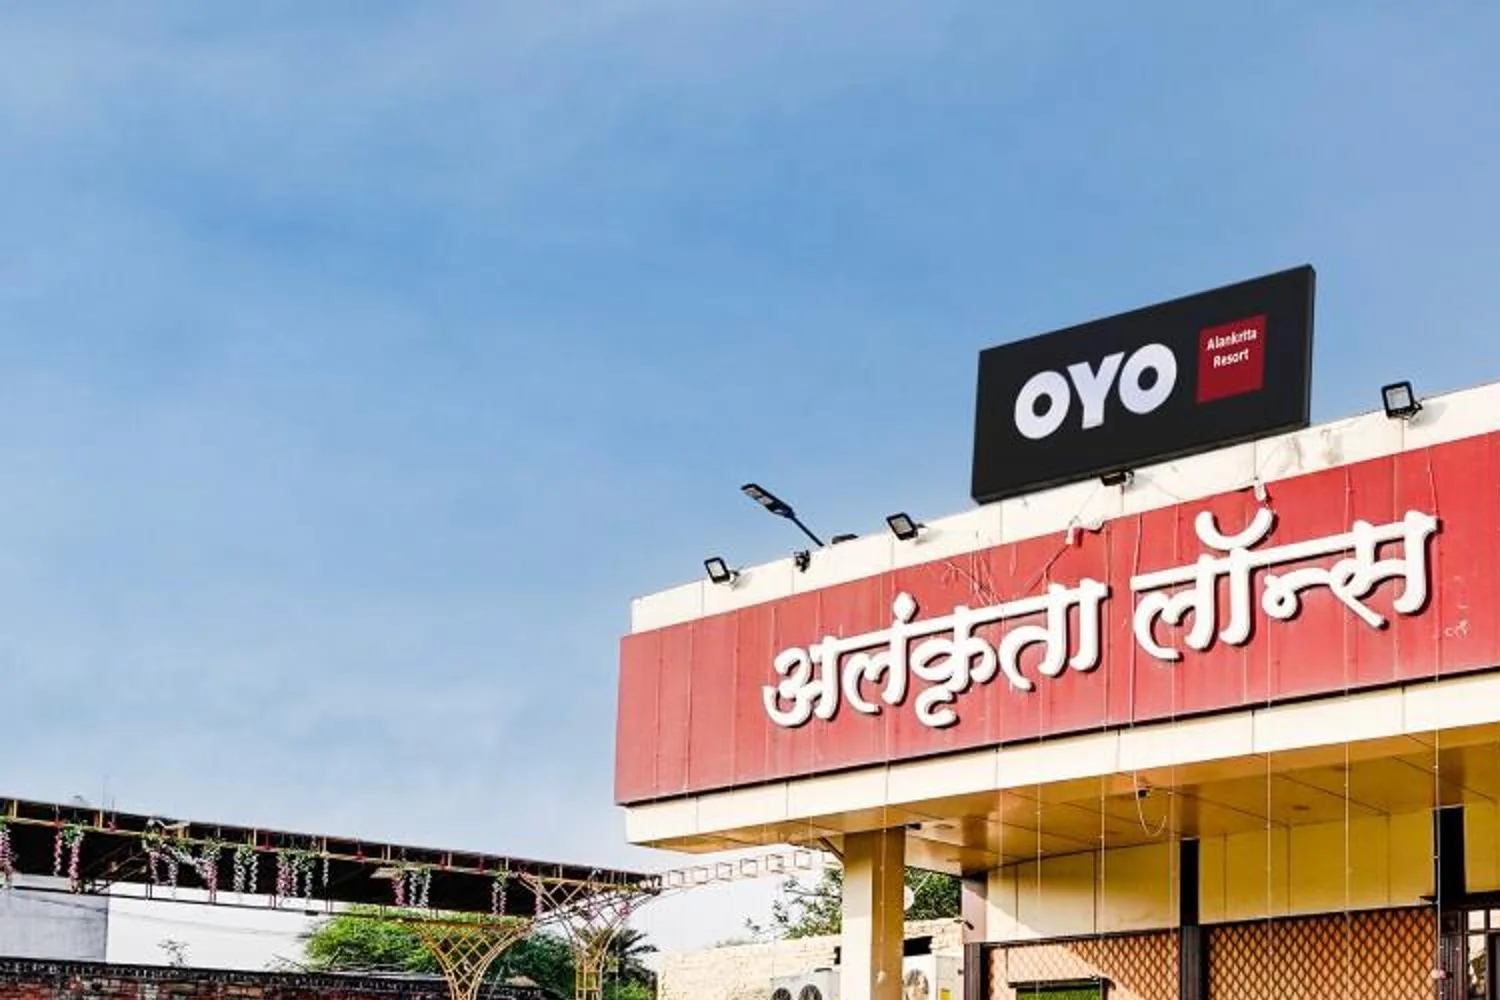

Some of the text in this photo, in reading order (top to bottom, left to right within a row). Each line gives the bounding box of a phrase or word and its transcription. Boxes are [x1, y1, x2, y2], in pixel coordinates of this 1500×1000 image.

[1206, 328, 1258, 351] Alankrita
[1213, 348, 1249, 369] Resort
[1014, 343, 1177, 439] OYO
[763, 507, 1439, 729] अलंकृता लॉन्स
